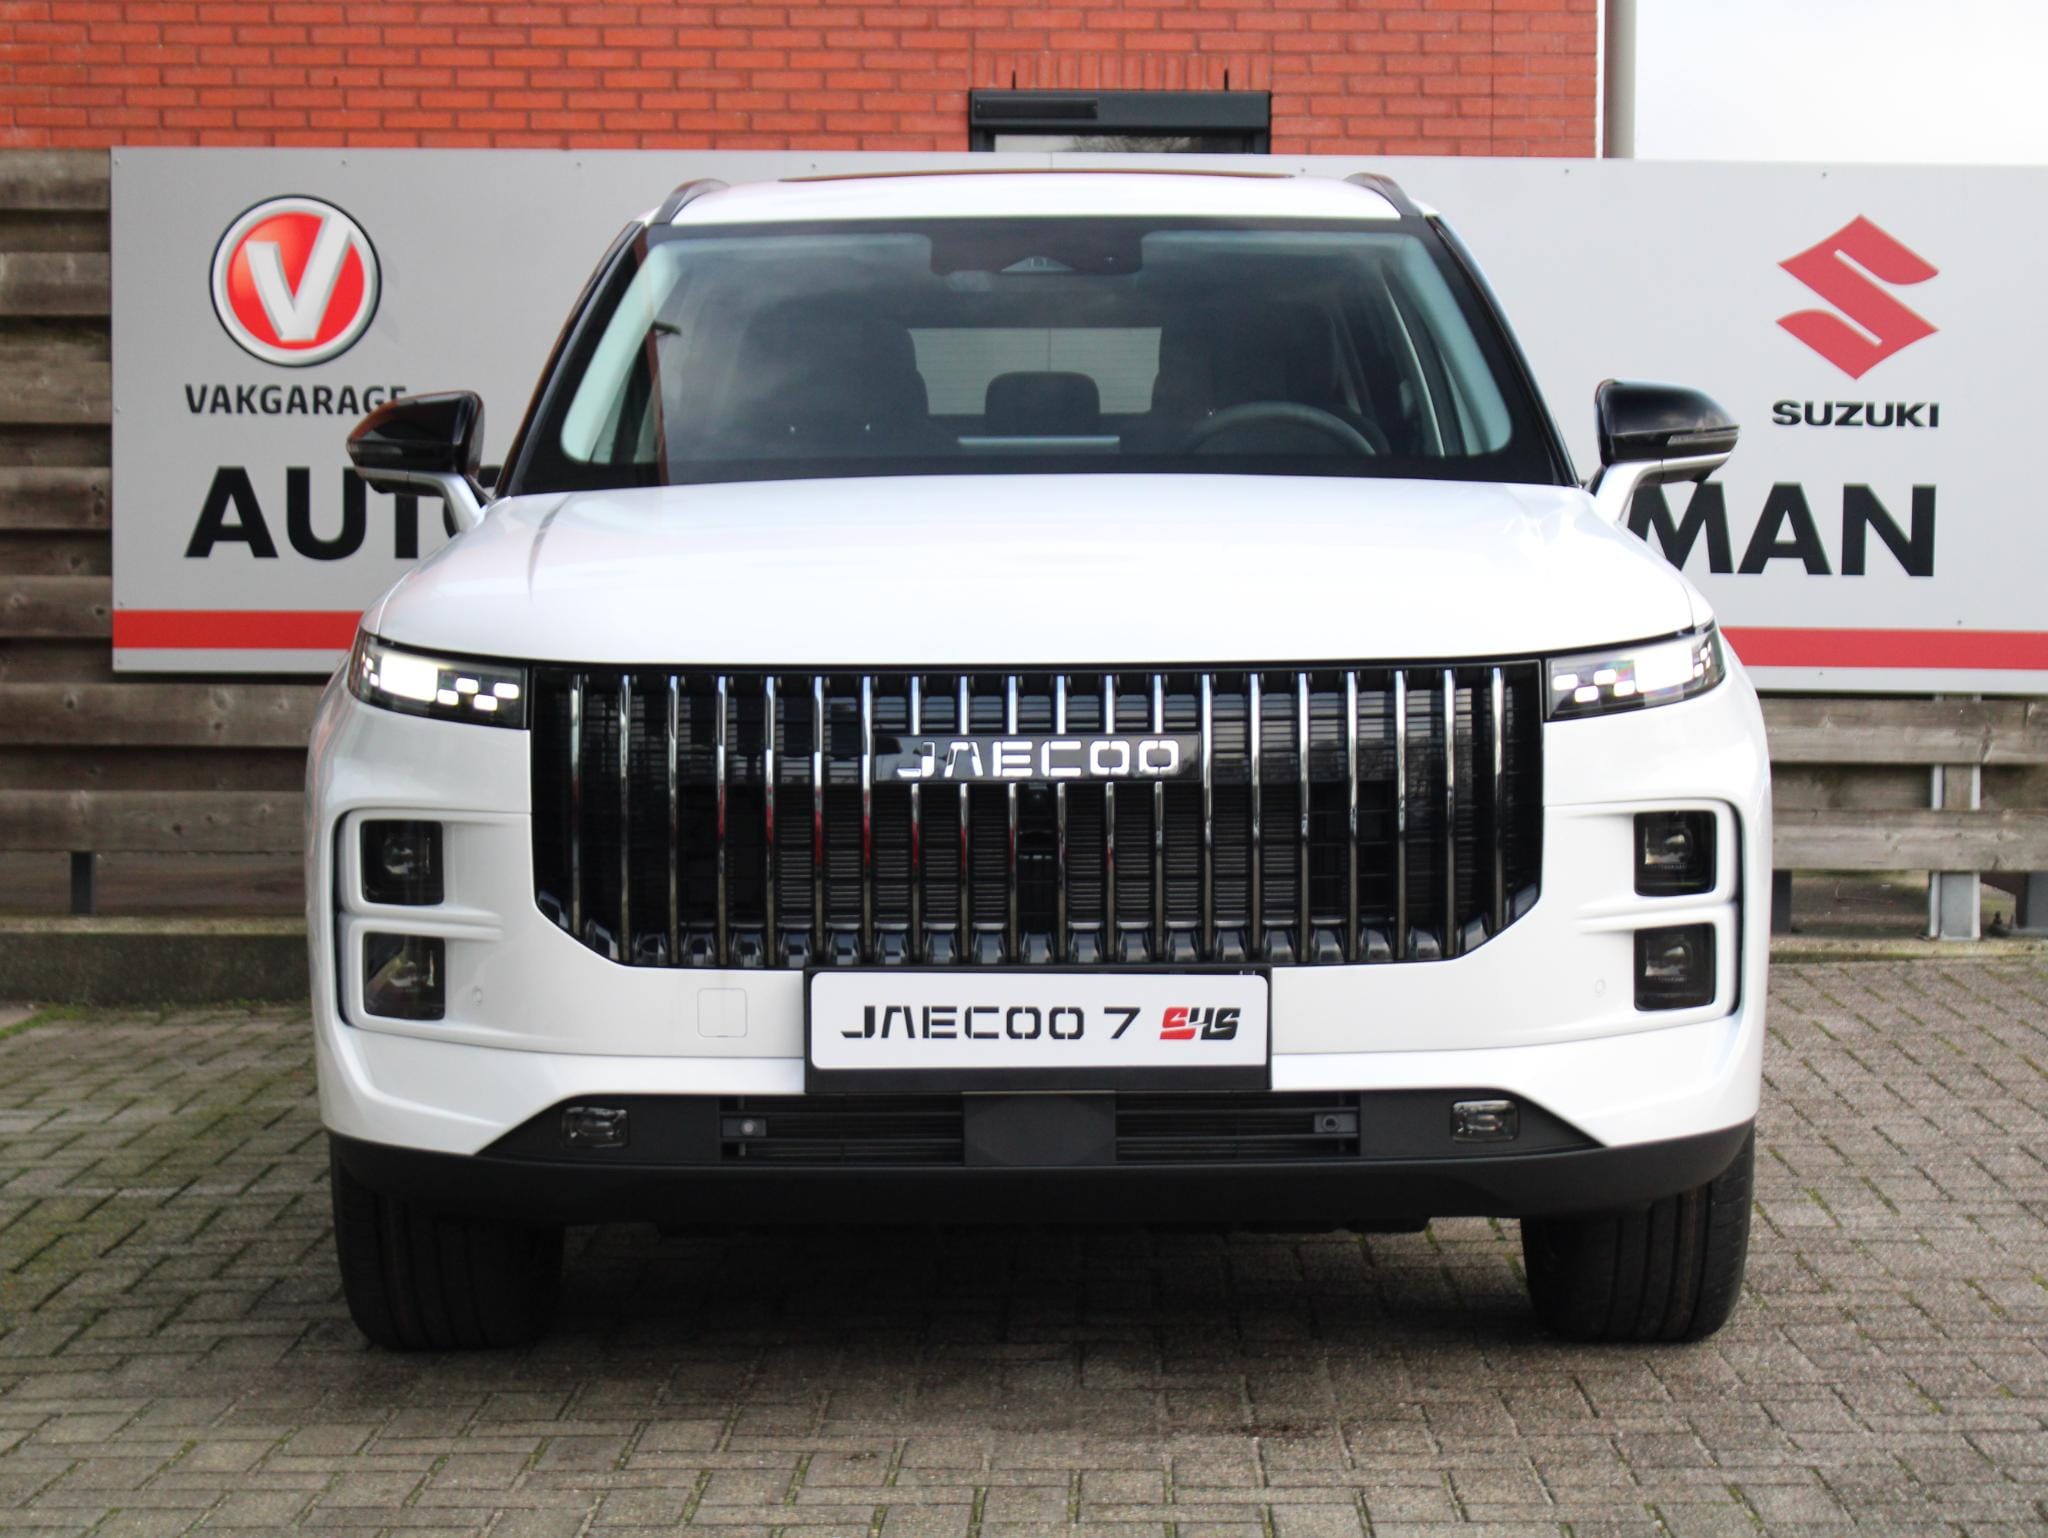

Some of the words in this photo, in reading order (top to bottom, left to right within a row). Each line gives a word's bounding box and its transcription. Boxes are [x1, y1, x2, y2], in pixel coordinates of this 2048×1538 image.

[1771, 399, 1939, 428] SUZUKI
[1582, 480, 1937, 576] MAN
[896, 740, 1179, 777] JAECOO
[841, 1006, 1084, 1039] JAECOO
[1104, 1007, 1141, 1040] 7
